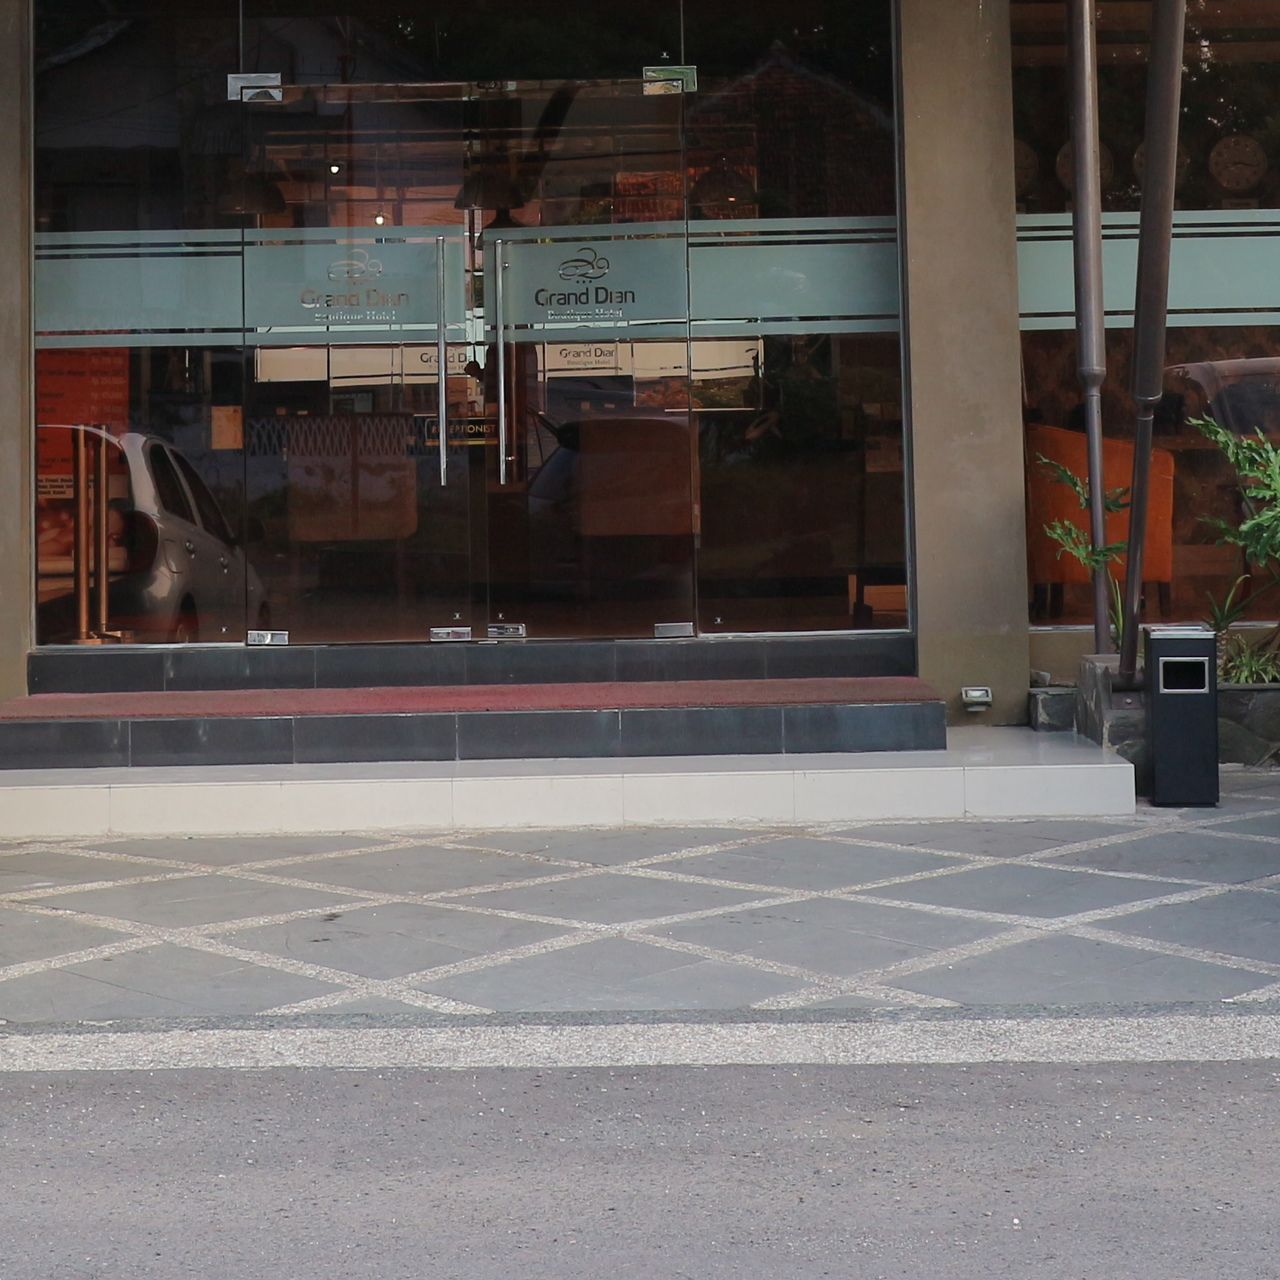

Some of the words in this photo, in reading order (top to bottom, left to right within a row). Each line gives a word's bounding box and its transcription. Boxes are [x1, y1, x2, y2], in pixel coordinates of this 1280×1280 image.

[301, 288, 360, 309] Grand
[535, 287, 589, 307] Grand
[595, 286, 636, 304] Dian
[559, 348, 592, 359] Grand
